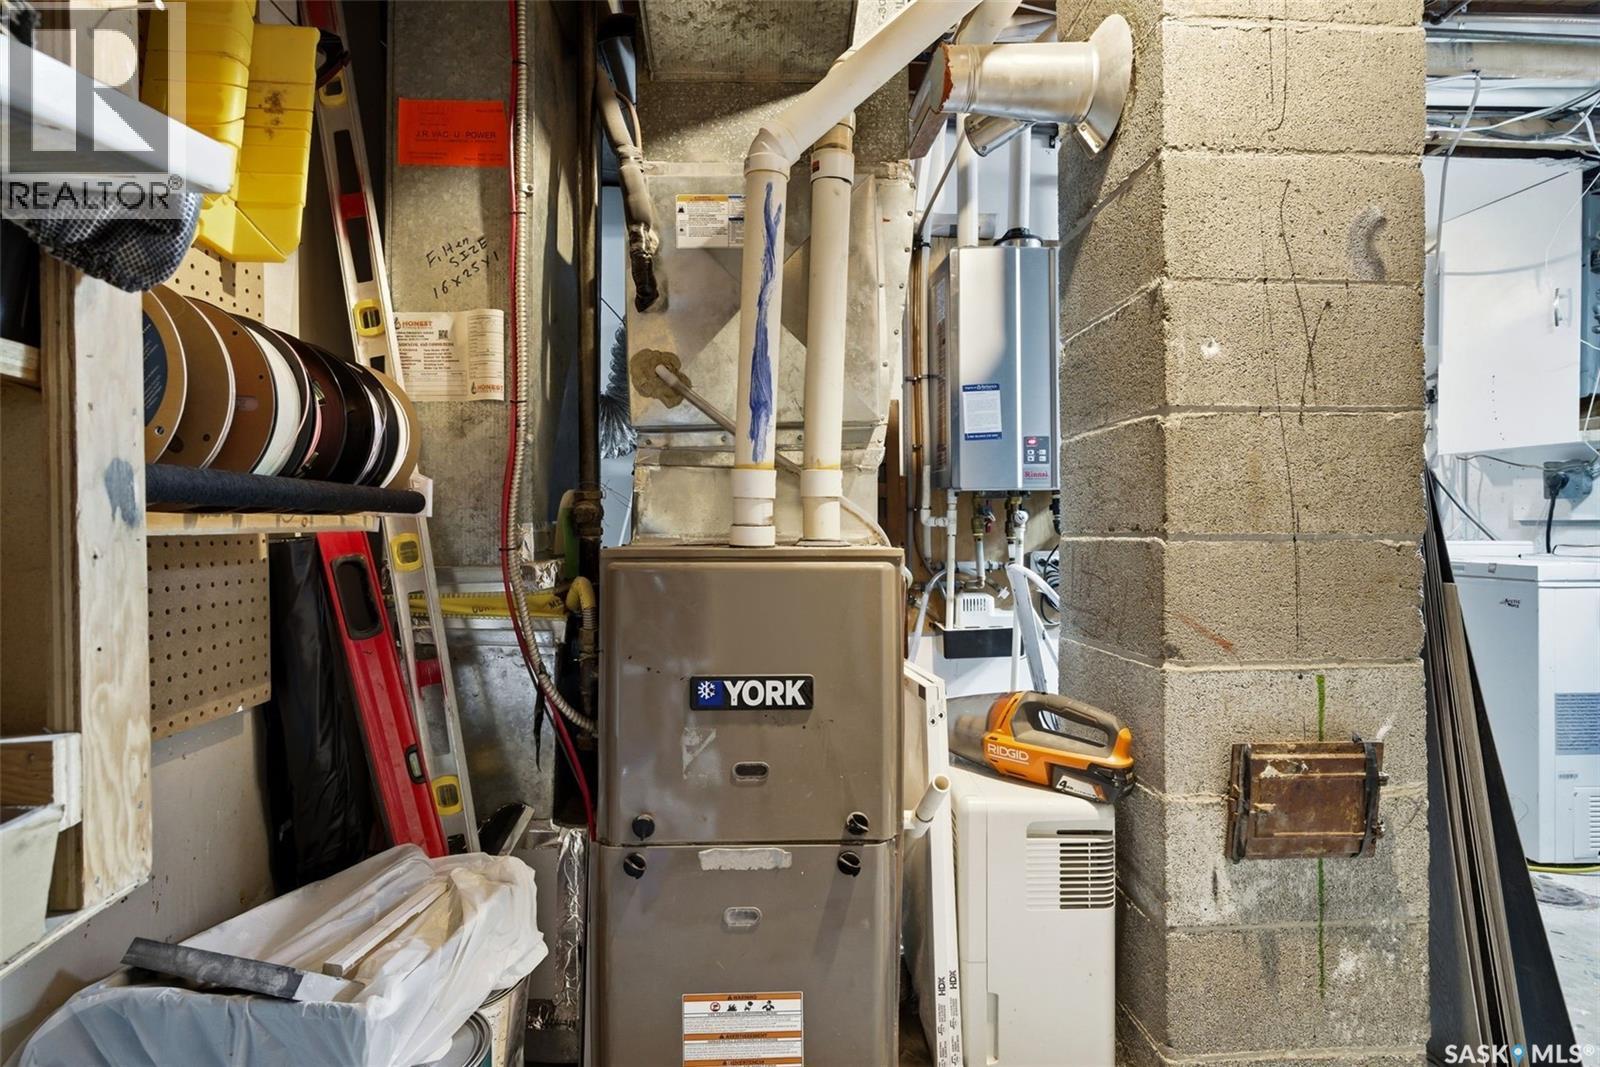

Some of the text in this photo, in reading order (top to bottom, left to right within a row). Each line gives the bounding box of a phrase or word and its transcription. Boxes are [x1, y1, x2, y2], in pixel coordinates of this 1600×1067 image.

[465, 131, 496, 139] POWER
[449, 237, 488, 268] SIZE
[723, 679, 806, 706] YORK
[987, 743, 1030, 761] RIDGID
[1059, 780, 1067, 788] 4
[938, 976, 946, 996] HDX
[949, 970, 957, 990] HDX
